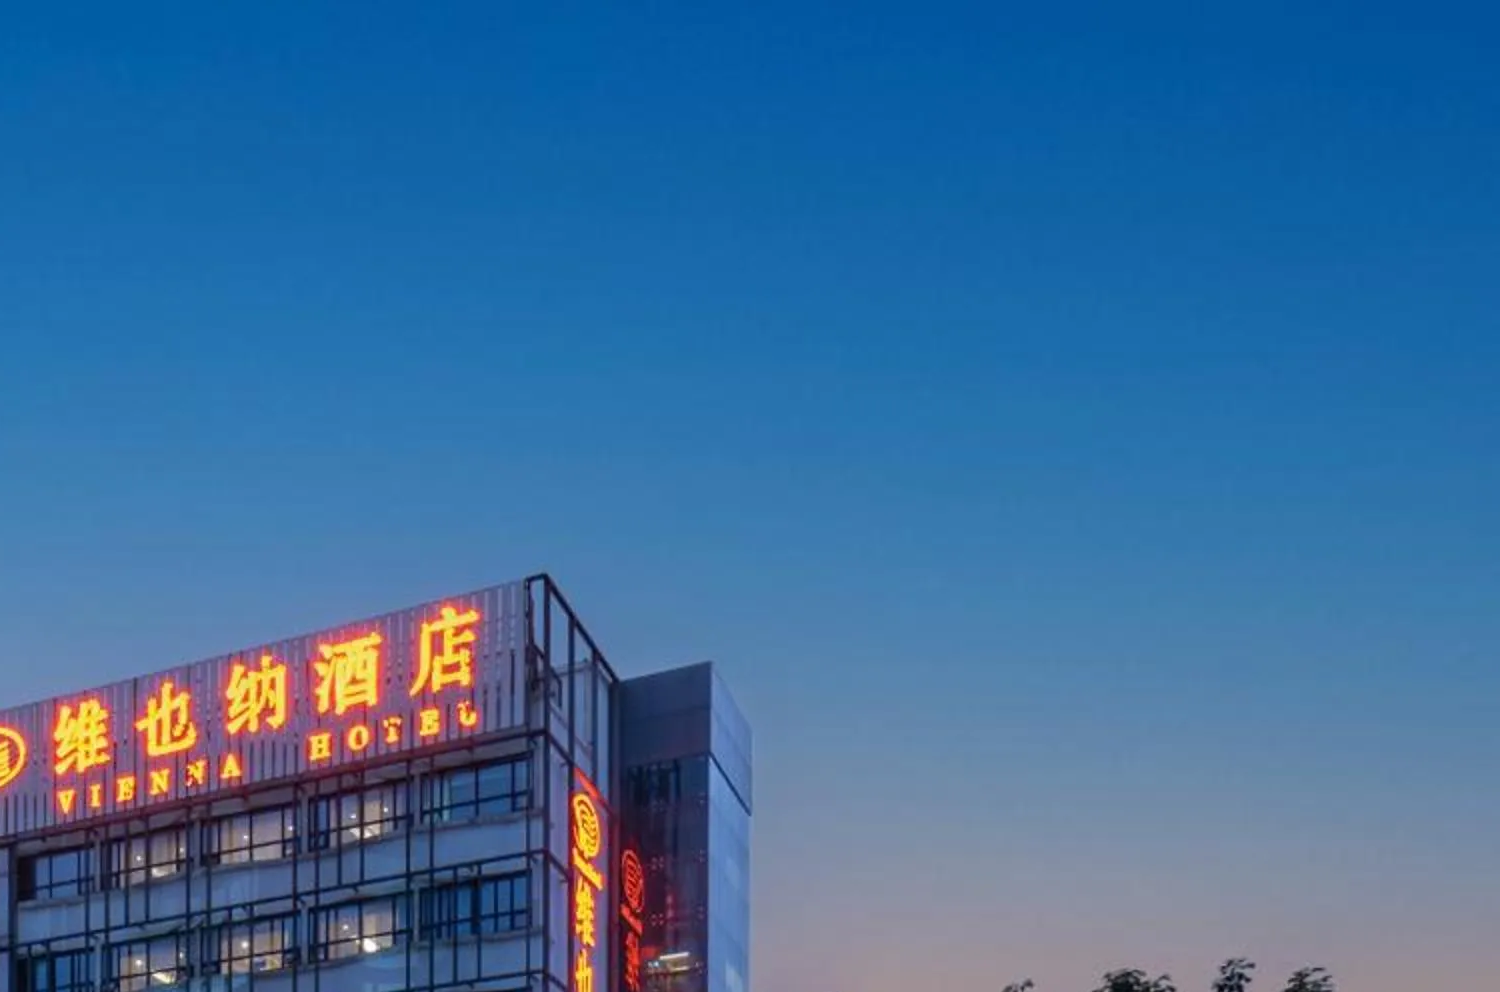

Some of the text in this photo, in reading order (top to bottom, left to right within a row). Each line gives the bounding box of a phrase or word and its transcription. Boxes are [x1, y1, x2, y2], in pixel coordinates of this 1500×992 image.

[52, 603, 481, 774] 维也纳酒店
[56, 753, 242, 814] VIENNA
